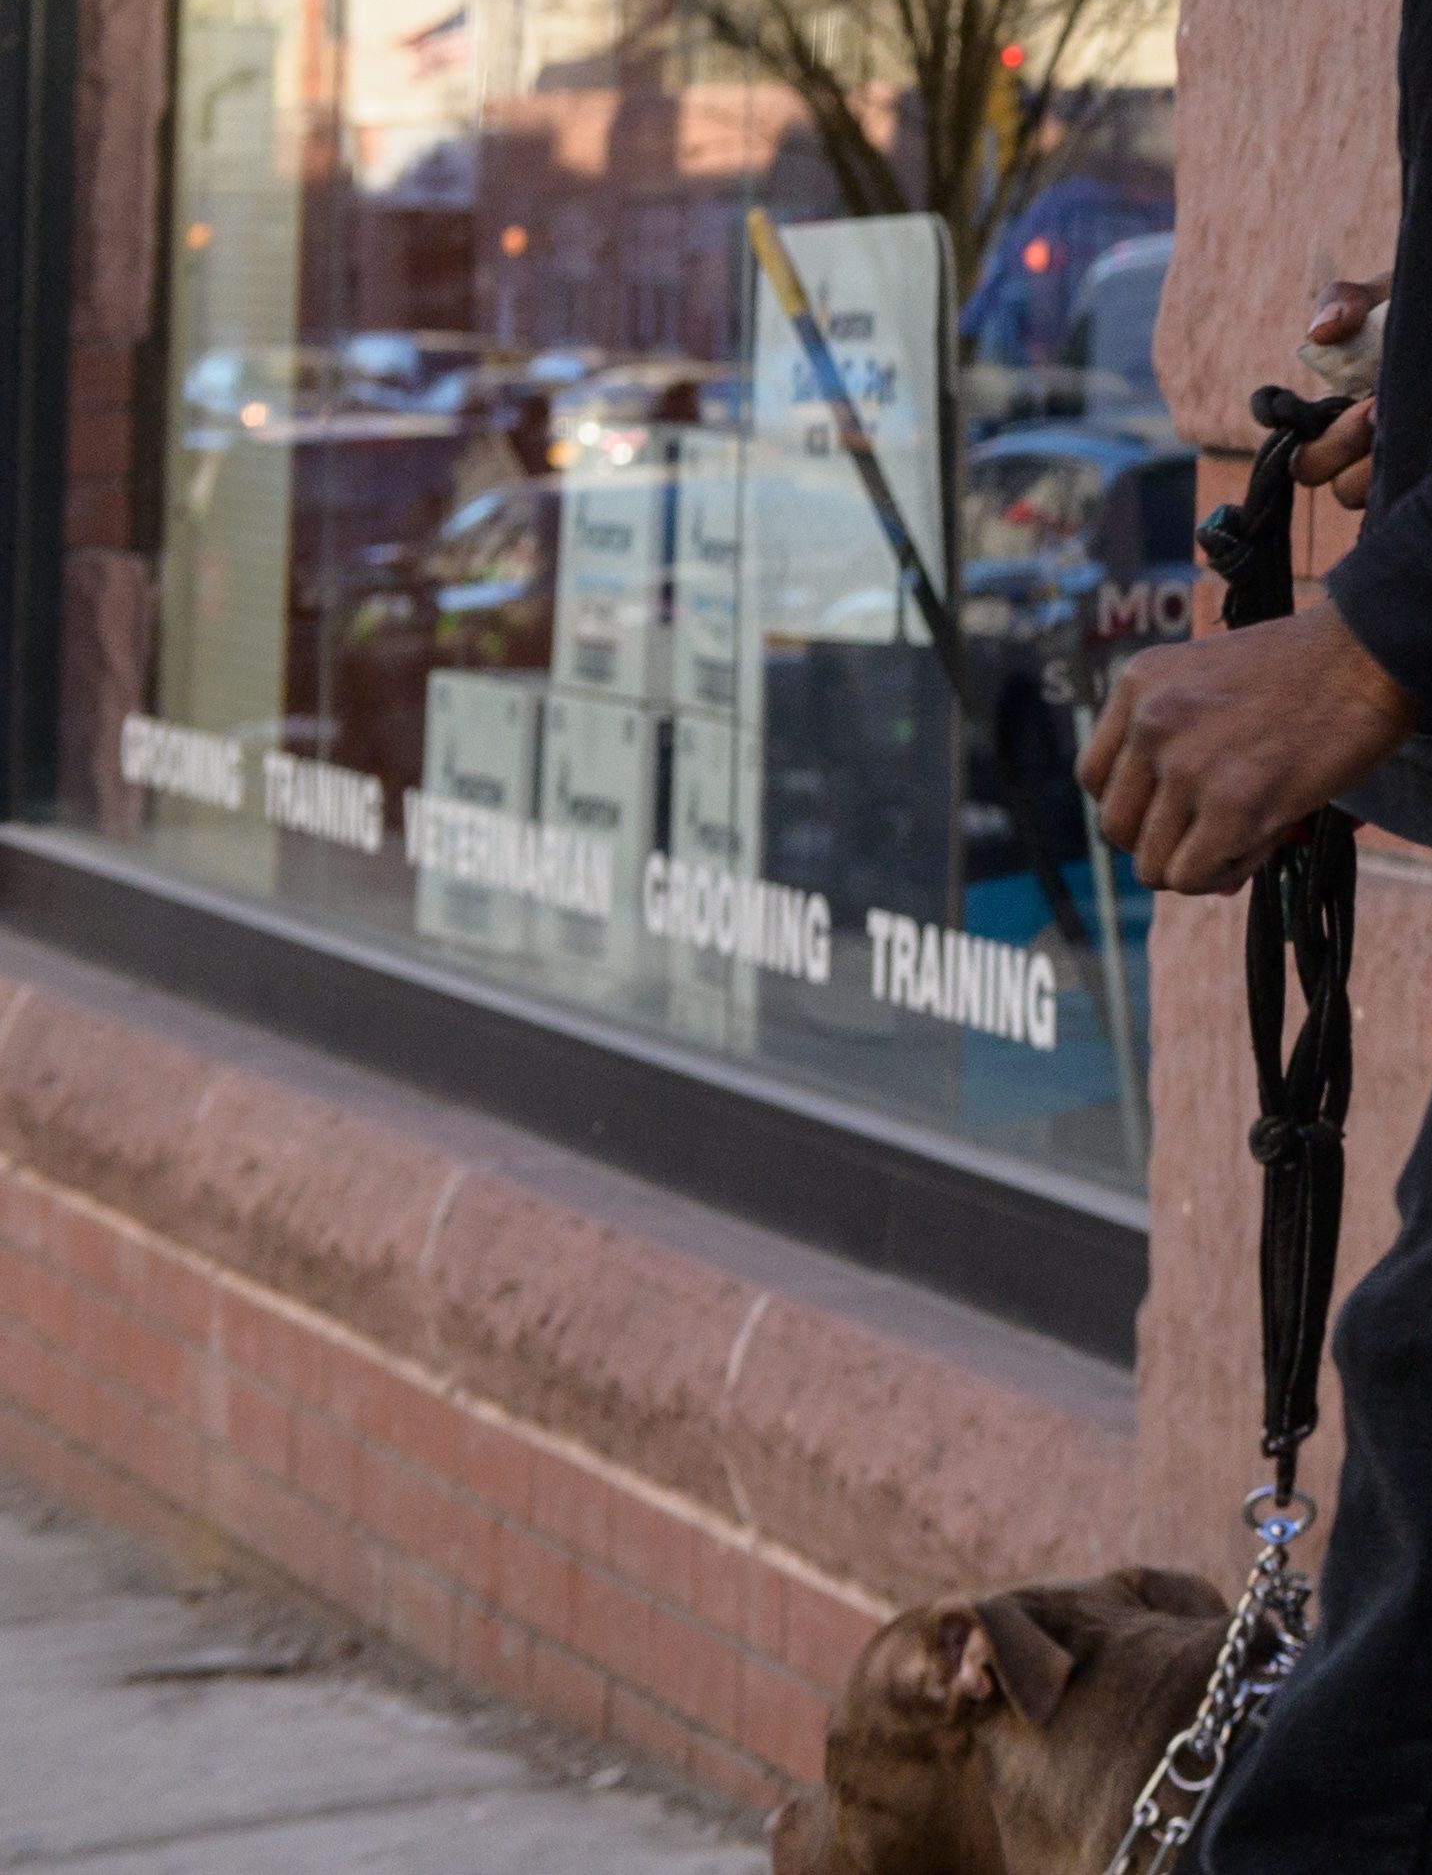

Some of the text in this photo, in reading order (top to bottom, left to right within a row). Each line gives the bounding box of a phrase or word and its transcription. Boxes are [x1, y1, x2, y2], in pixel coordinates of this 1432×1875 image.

[119, 715, 246, 810] GROOMING
[262, 752, 383, 854] TRAINING
[404, 789, 615, 917] VETERINARIAN
[643, 852, 832, 983] GROOMING
[865, 907, 1059, 1049] TRAINING
